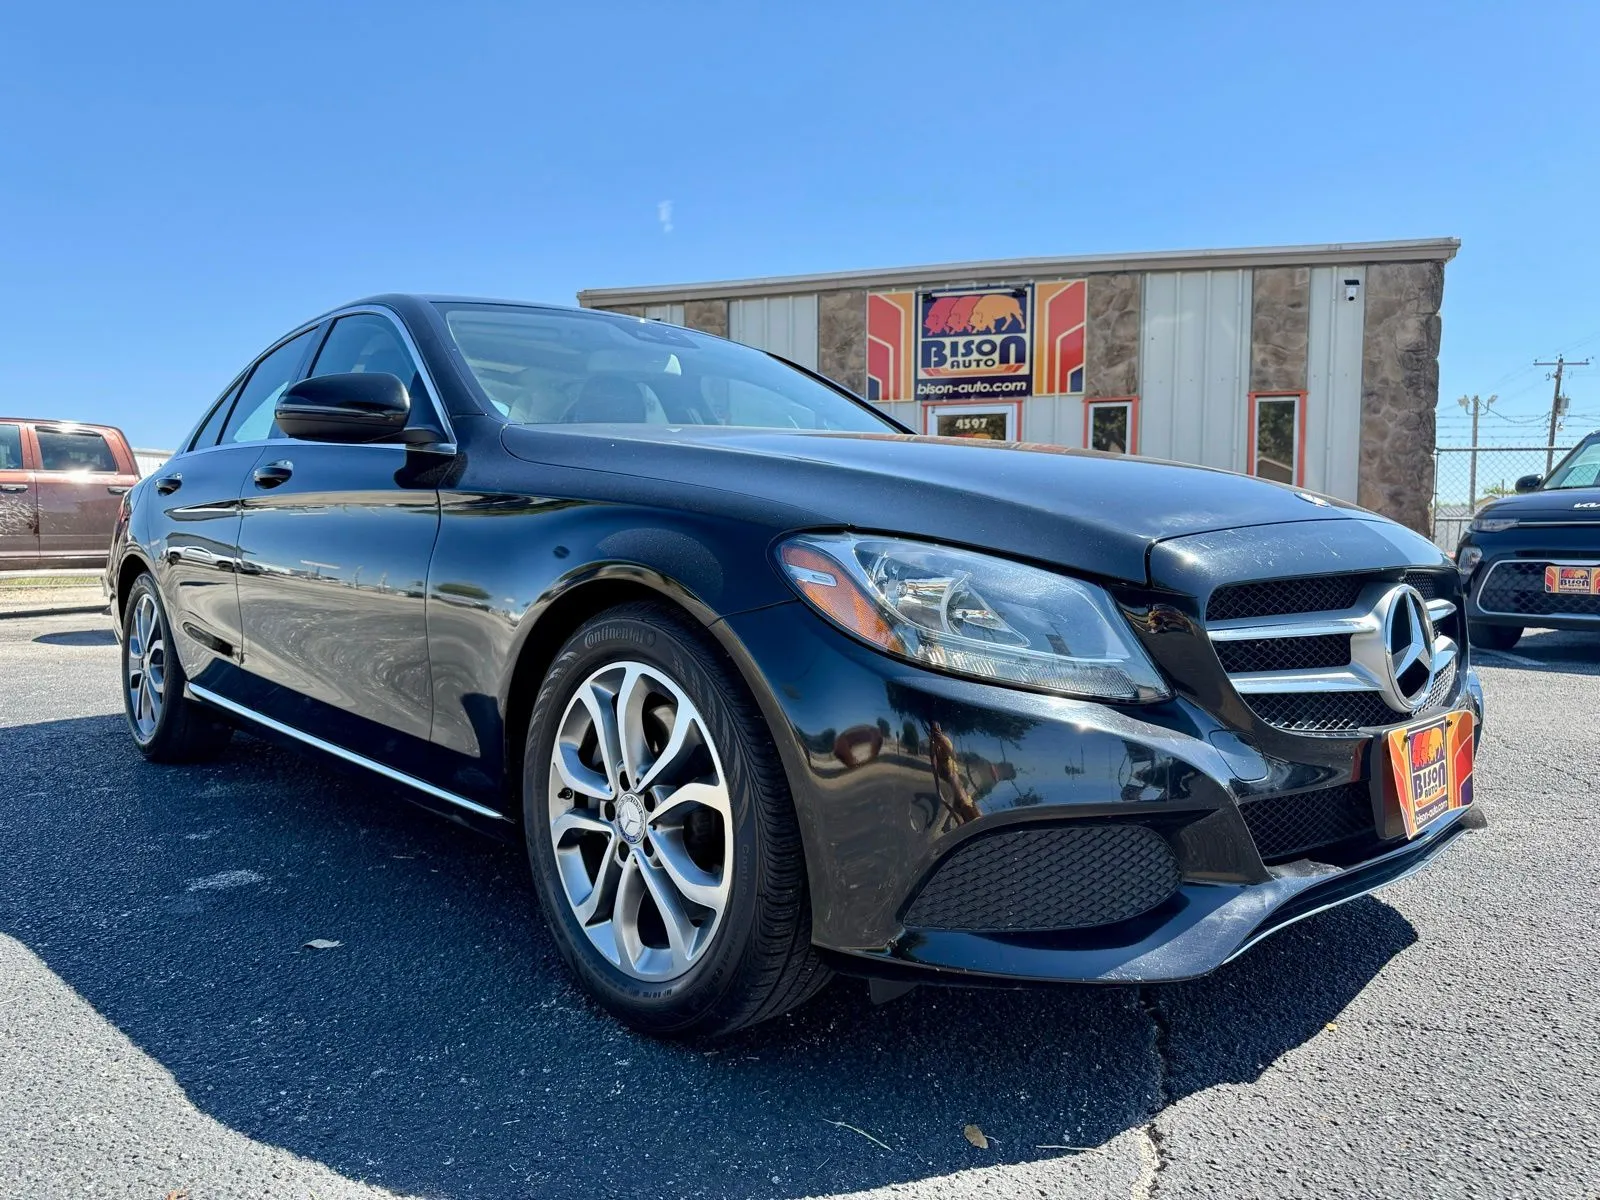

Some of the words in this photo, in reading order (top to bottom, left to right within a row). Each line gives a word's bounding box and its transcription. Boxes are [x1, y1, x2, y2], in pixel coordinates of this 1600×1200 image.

[921, 335, 1027, 369] BISON
[950, 358, 996, 369] AUTO
[917, 380, 1027, 395] bison-auto.com
[584, 625, 644, 649] Continental
[1412, 761, 1446, 801] BISON
